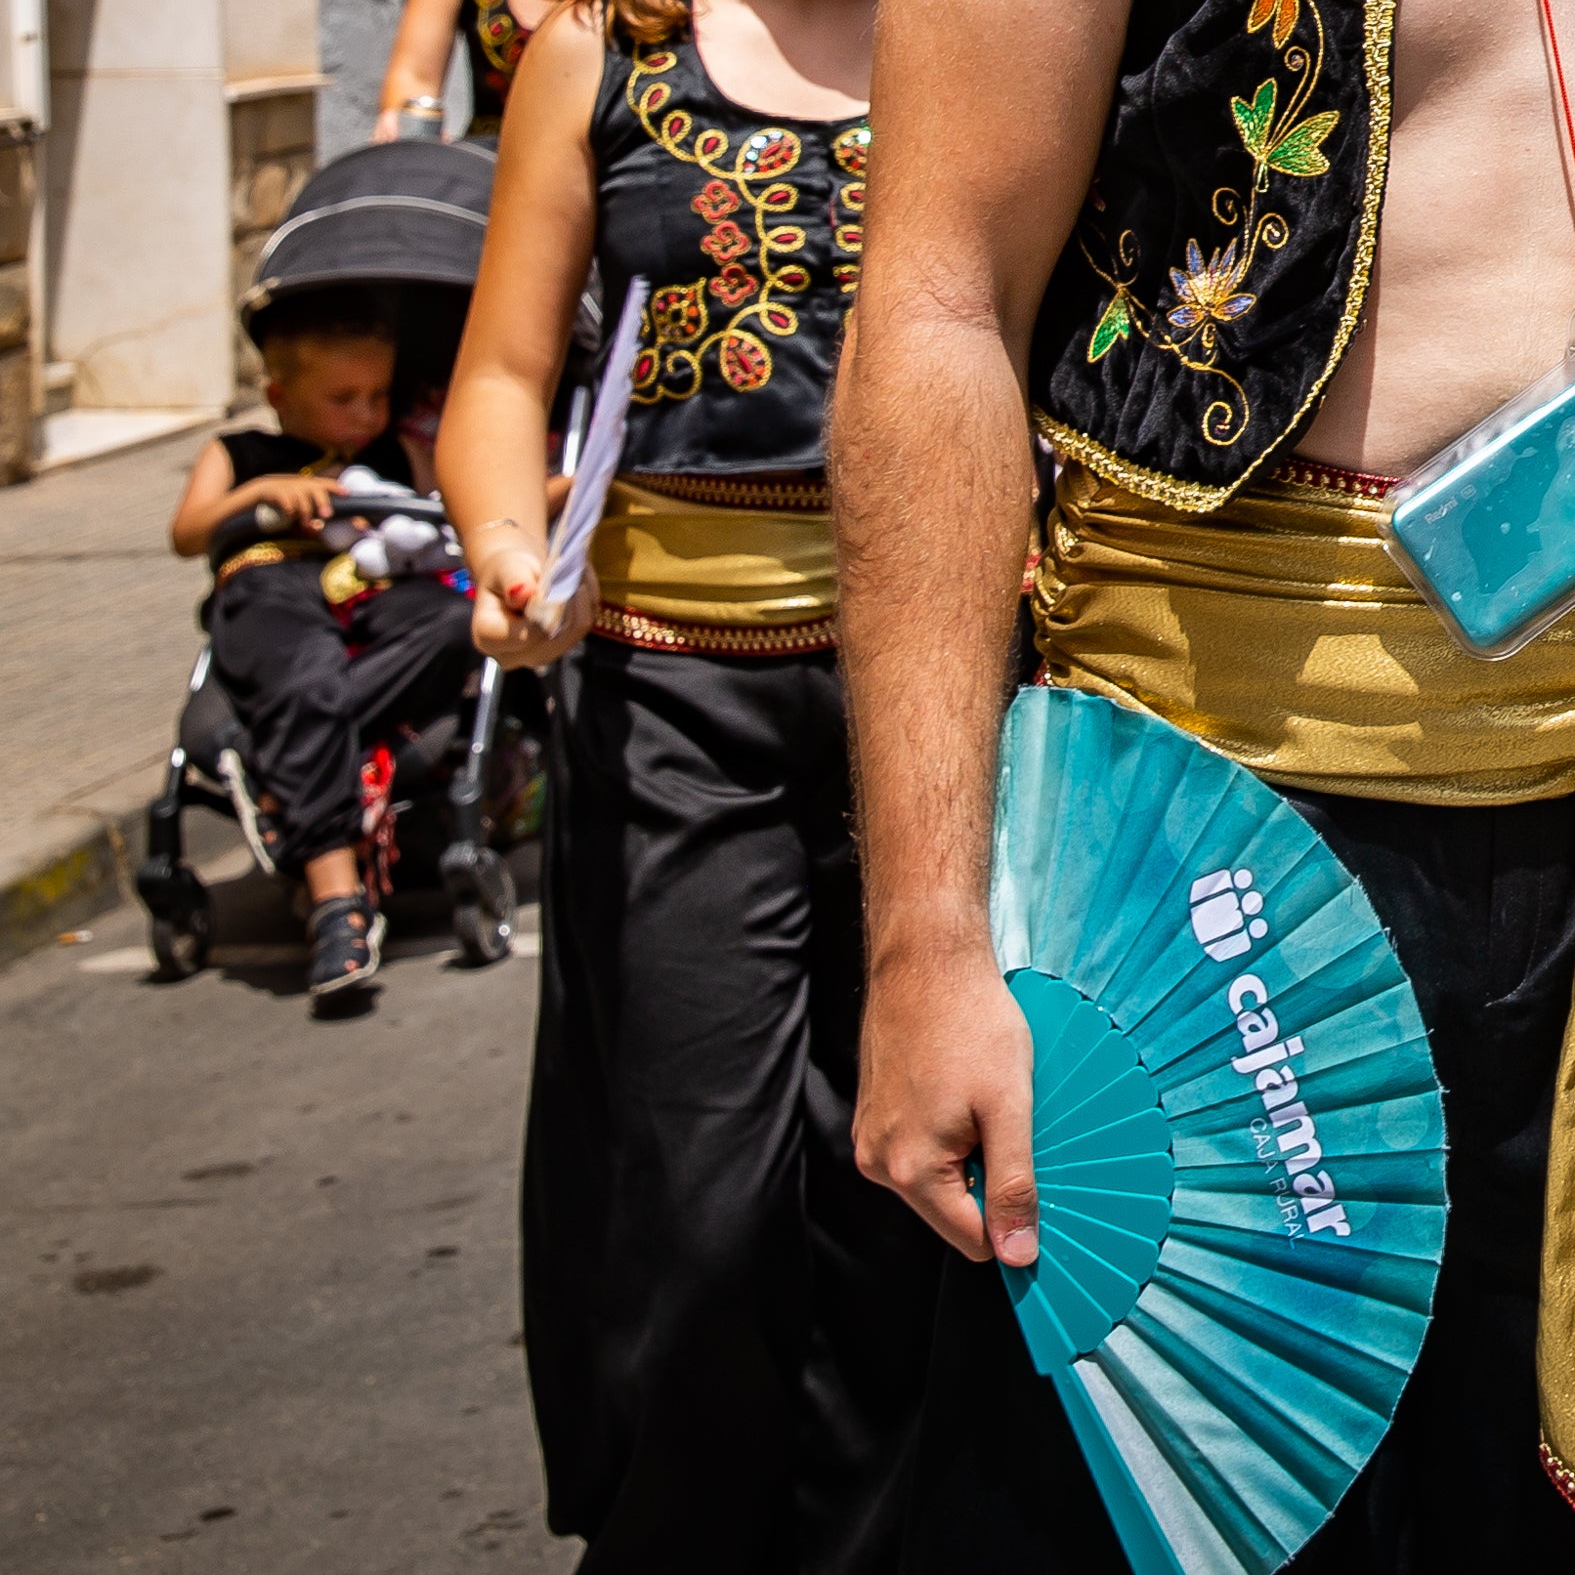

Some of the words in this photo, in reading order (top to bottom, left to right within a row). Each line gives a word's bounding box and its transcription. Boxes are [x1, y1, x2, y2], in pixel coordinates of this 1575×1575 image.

[1228, 974, 1351, 1237] cajamar
[1249, 1117, 1279, 1174] CAJA
[1268, 1177, 1304, 1250] RURAL
